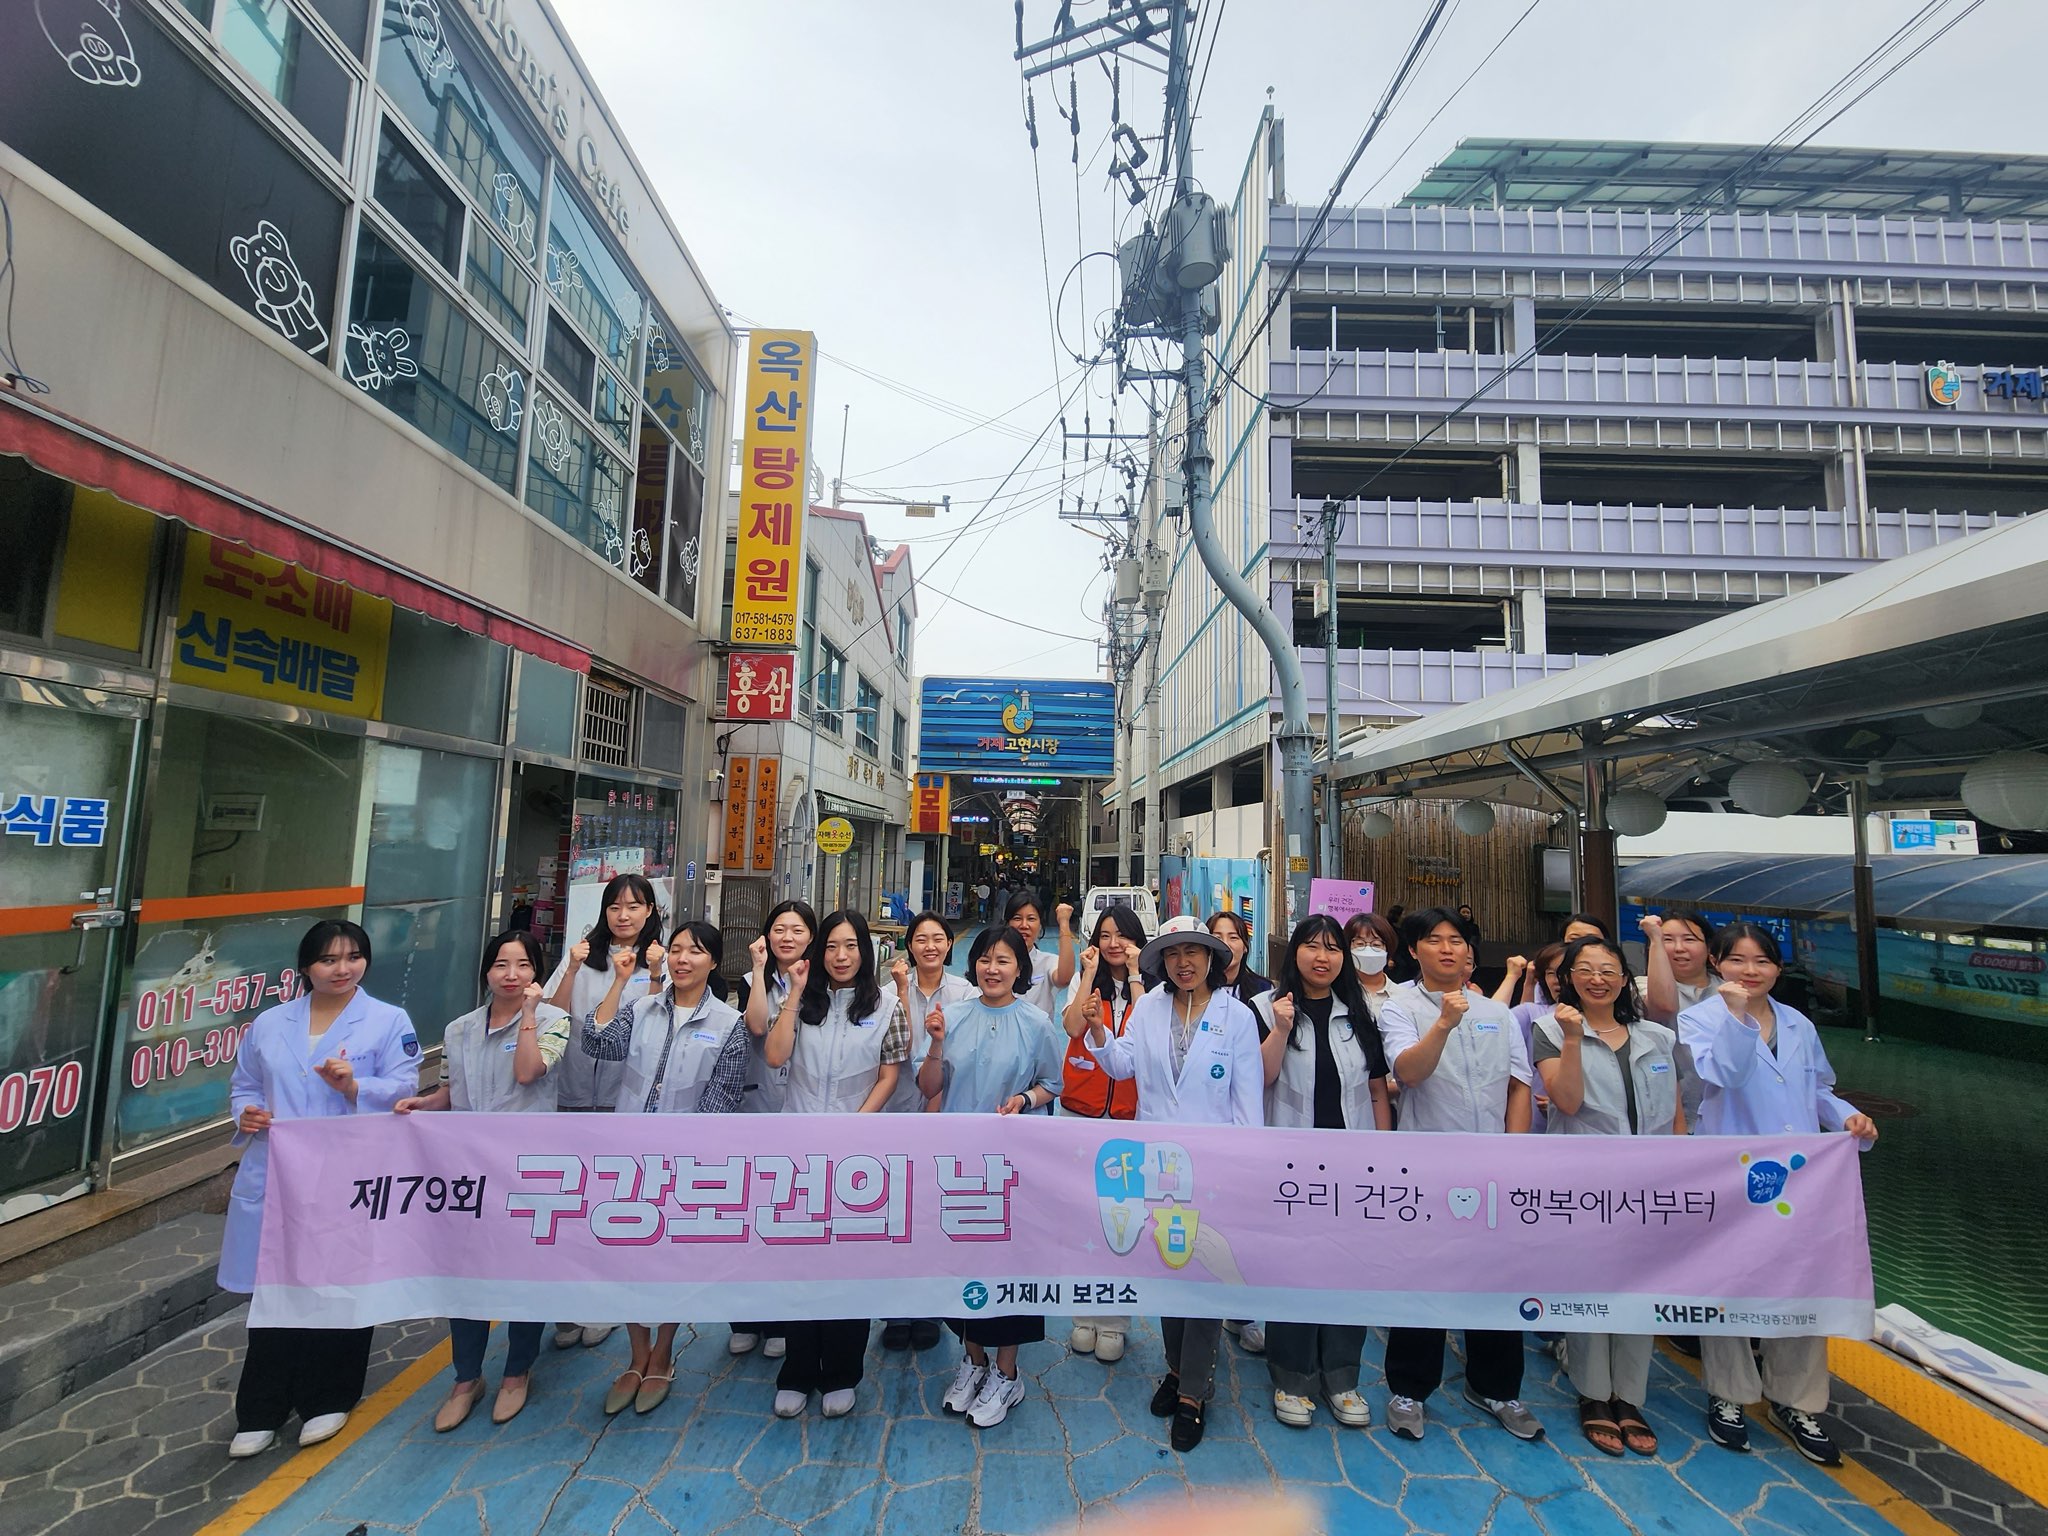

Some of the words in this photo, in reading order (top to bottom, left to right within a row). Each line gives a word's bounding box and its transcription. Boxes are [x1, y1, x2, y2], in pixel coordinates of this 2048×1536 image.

[577, 135, 630, 235] Cafe
[745, 340, 803, 602] 옥산탕제원
[735, 612, 794, 626] 017-581-4579
[735, 628, 793, 641] 637-1883
[176, 610, 360, 701] 신속배달
[730, 666, 791, 715] 홍삼
[977, 736, 1060, 755] 거제고현시장
[0, 794, 108, 847] 식품
[0, 1061, 83, 1134] 070
[349, 1174, 486, 1221] 제79회
[506, 1153, 915, 1248] 구강보건의
[934, 1154, 1019, 1243] 날
[1273, 1180, 1341, 1217] 우리
[1354, 1182, 1432, 1224] 건강,
[1508, 1187, 1716, 1226] 행복에서부터
[996, 1282, 1062, 1306] 거제시
[1072, 1282, 1139, 1305] 보건소
[1550, 1302, 1610, 1318] 보건복지부
[1729, 1312, 1818, 1326] 한국건강증진개발원
